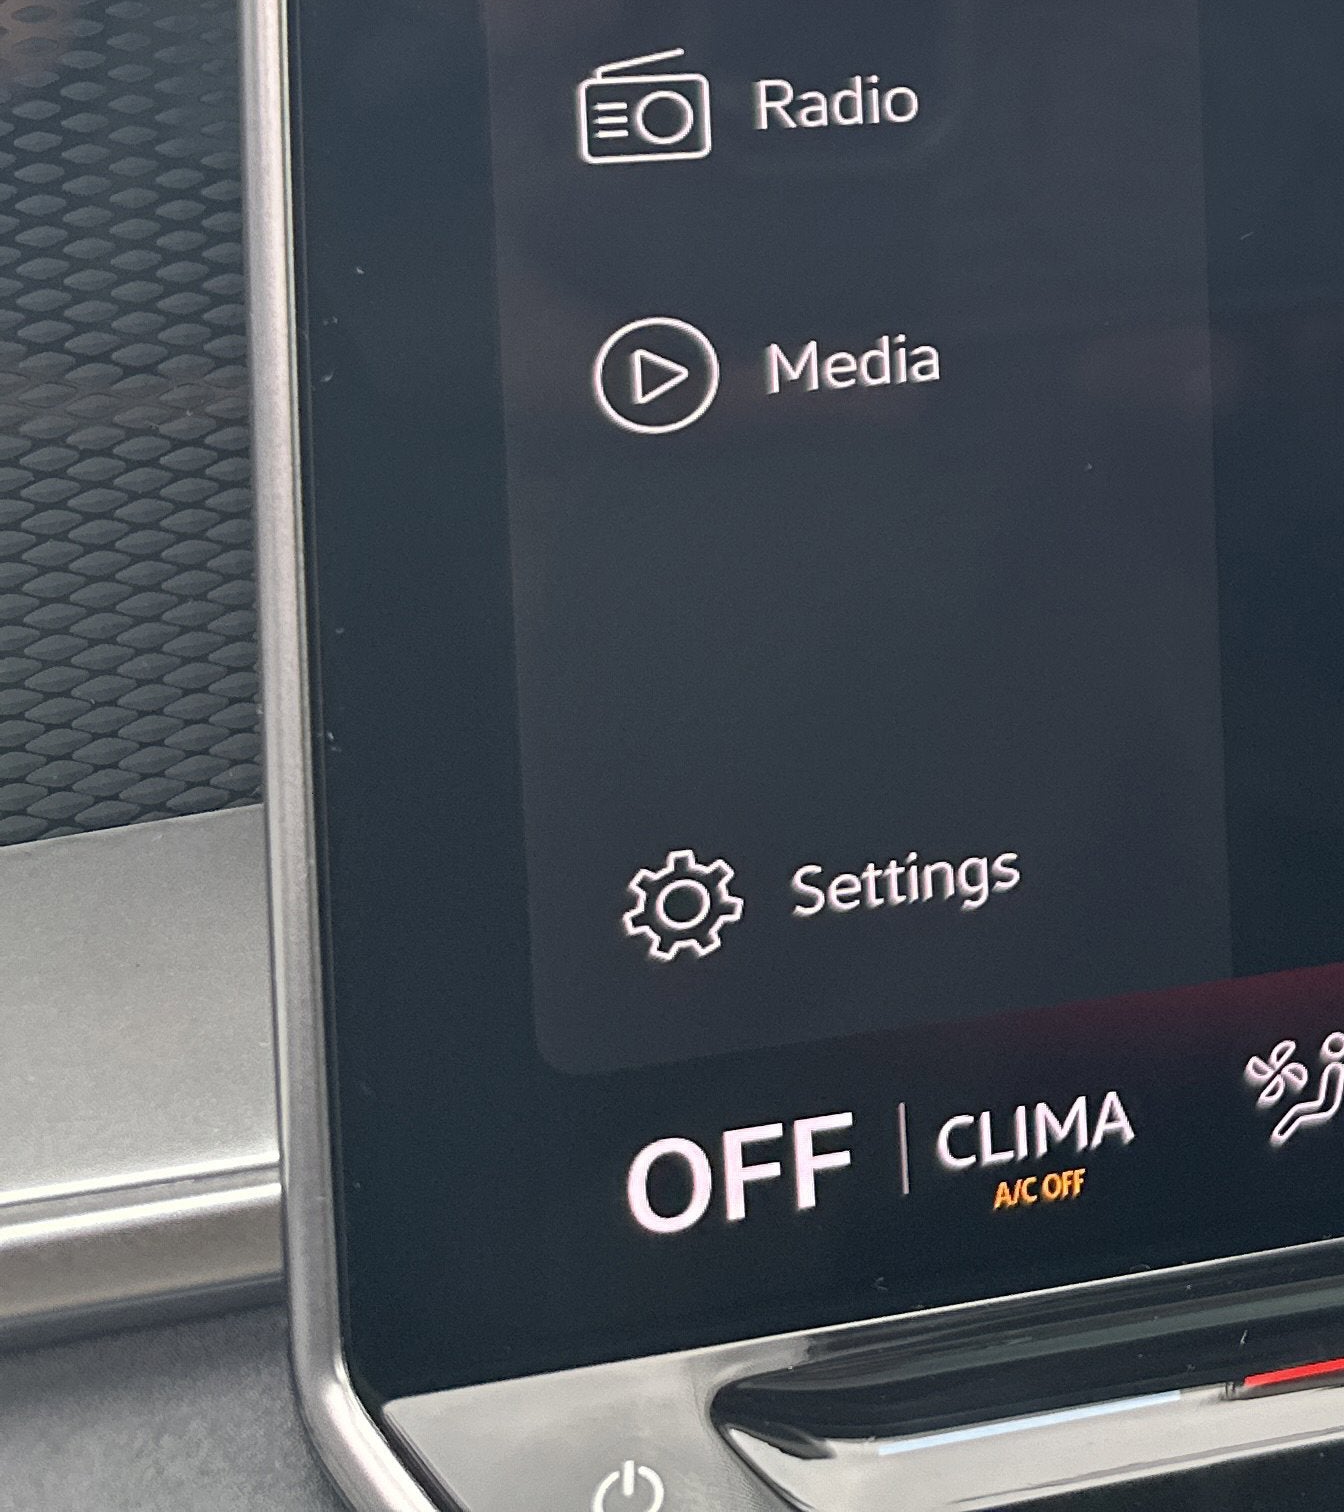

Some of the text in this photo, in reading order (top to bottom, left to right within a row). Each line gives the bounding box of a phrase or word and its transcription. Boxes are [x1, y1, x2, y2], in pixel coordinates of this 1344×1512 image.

[754, 74, 920, 131] Radio
[766, 334, 941, 395] Media
[792, 851, 1020, 917] Settings
[936, 1090, 1136, 1169] CLIMA
[626, 1112, 854, 1234] OFF
[993, 1168, 1086, 1210] A/C OFF
